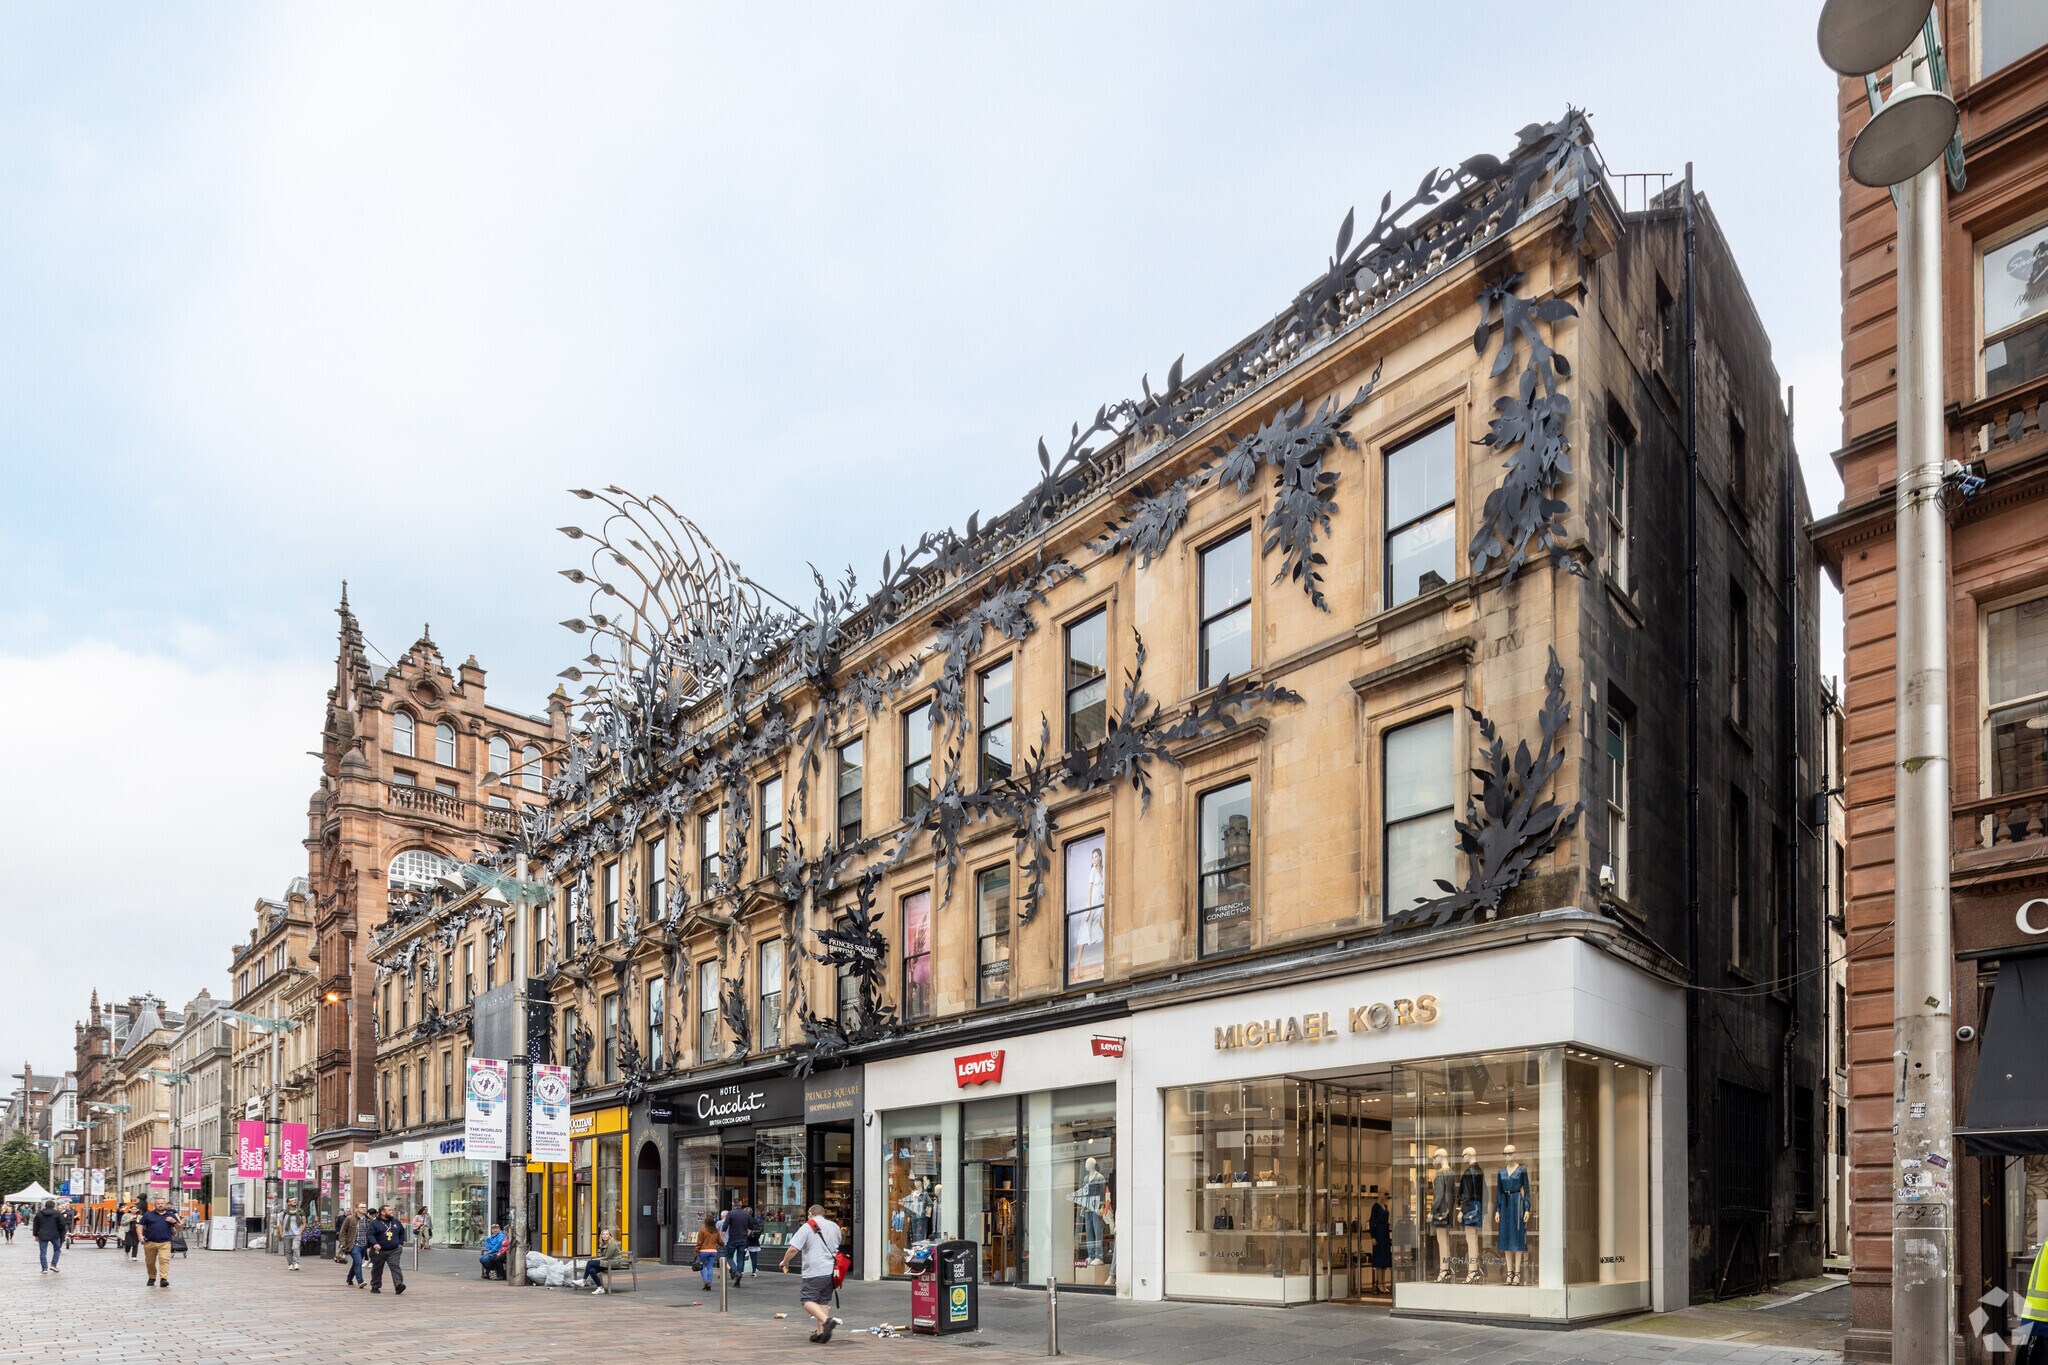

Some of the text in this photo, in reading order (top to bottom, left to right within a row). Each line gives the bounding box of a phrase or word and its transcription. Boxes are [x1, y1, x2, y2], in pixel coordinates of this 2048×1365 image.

[1206, 906, 1251, 921] CONNECTION
[1215, 902, 1244, 912] FRENCH
[829, 938, 878, 954] PRINCES SQUARE
[983, 965, 1010, 976] CONNECTIO
[1214, 994, 1438, 1050] MICHAEL KORS
[720, 1085, 740, 1096] HOTEL
[806, 1085, 860, 1102] PRINCES SQUARE
[809, 1103, 831, 1112] SHOPPING
[836, 1100, 853, 1108] DINING
[440, 1138, 465, 1154] OFFIC
[1482, 1257, 1506, 1265] KORS
